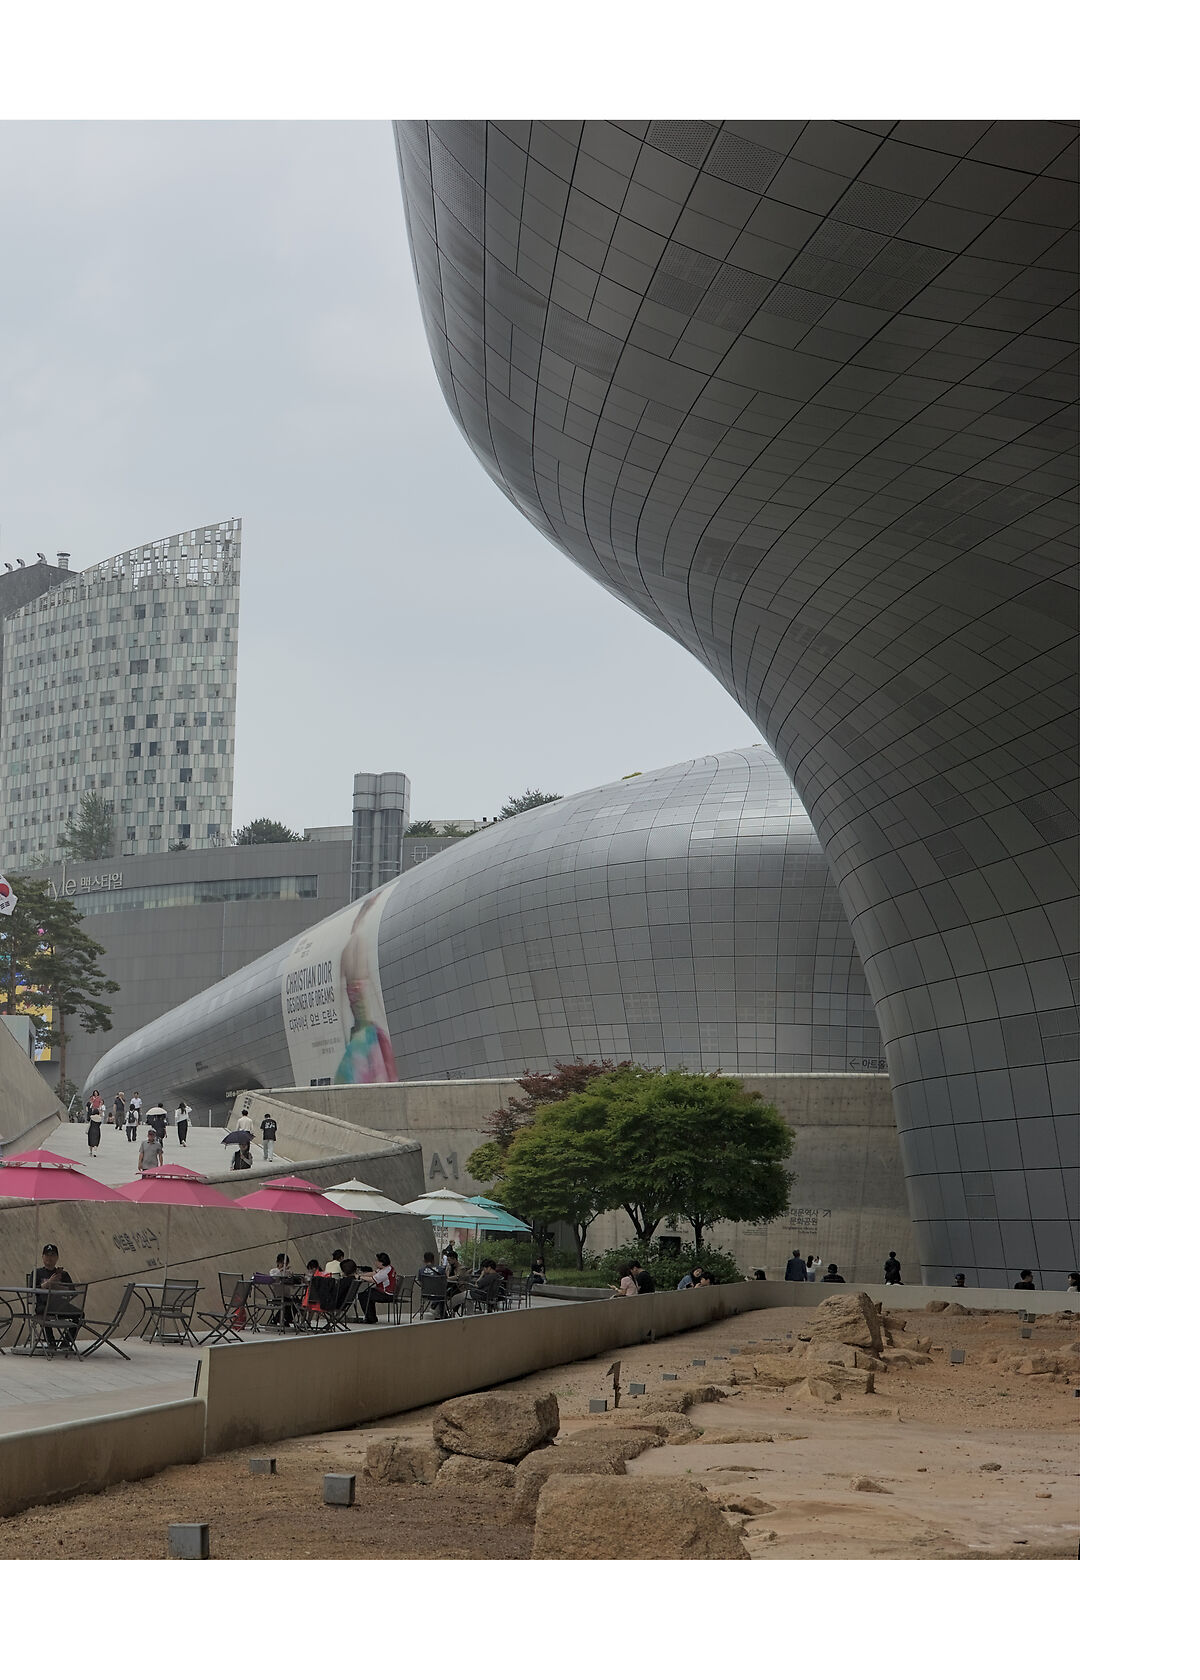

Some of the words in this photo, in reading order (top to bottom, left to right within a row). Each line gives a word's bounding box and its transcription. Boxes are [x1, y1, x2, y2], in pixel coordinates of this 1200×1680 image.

[80, 871, 124, 893] 맥스타일
[286, 966, 316, 994] CHRISTIAN
[317, 960, 333, 986] DIOR
[286, 993, 308, 1014] DESIGNER
[308, 990, 315, 1008] OF
[315, 985, 335, 1007] DREAMS
[289, 1014, 309, 1033] 디자이너
[310, 1012, 321, 1027] 오브
[322, 1008, 338, 1025] 드림스
[429, 1152, 461, 1180] A1
